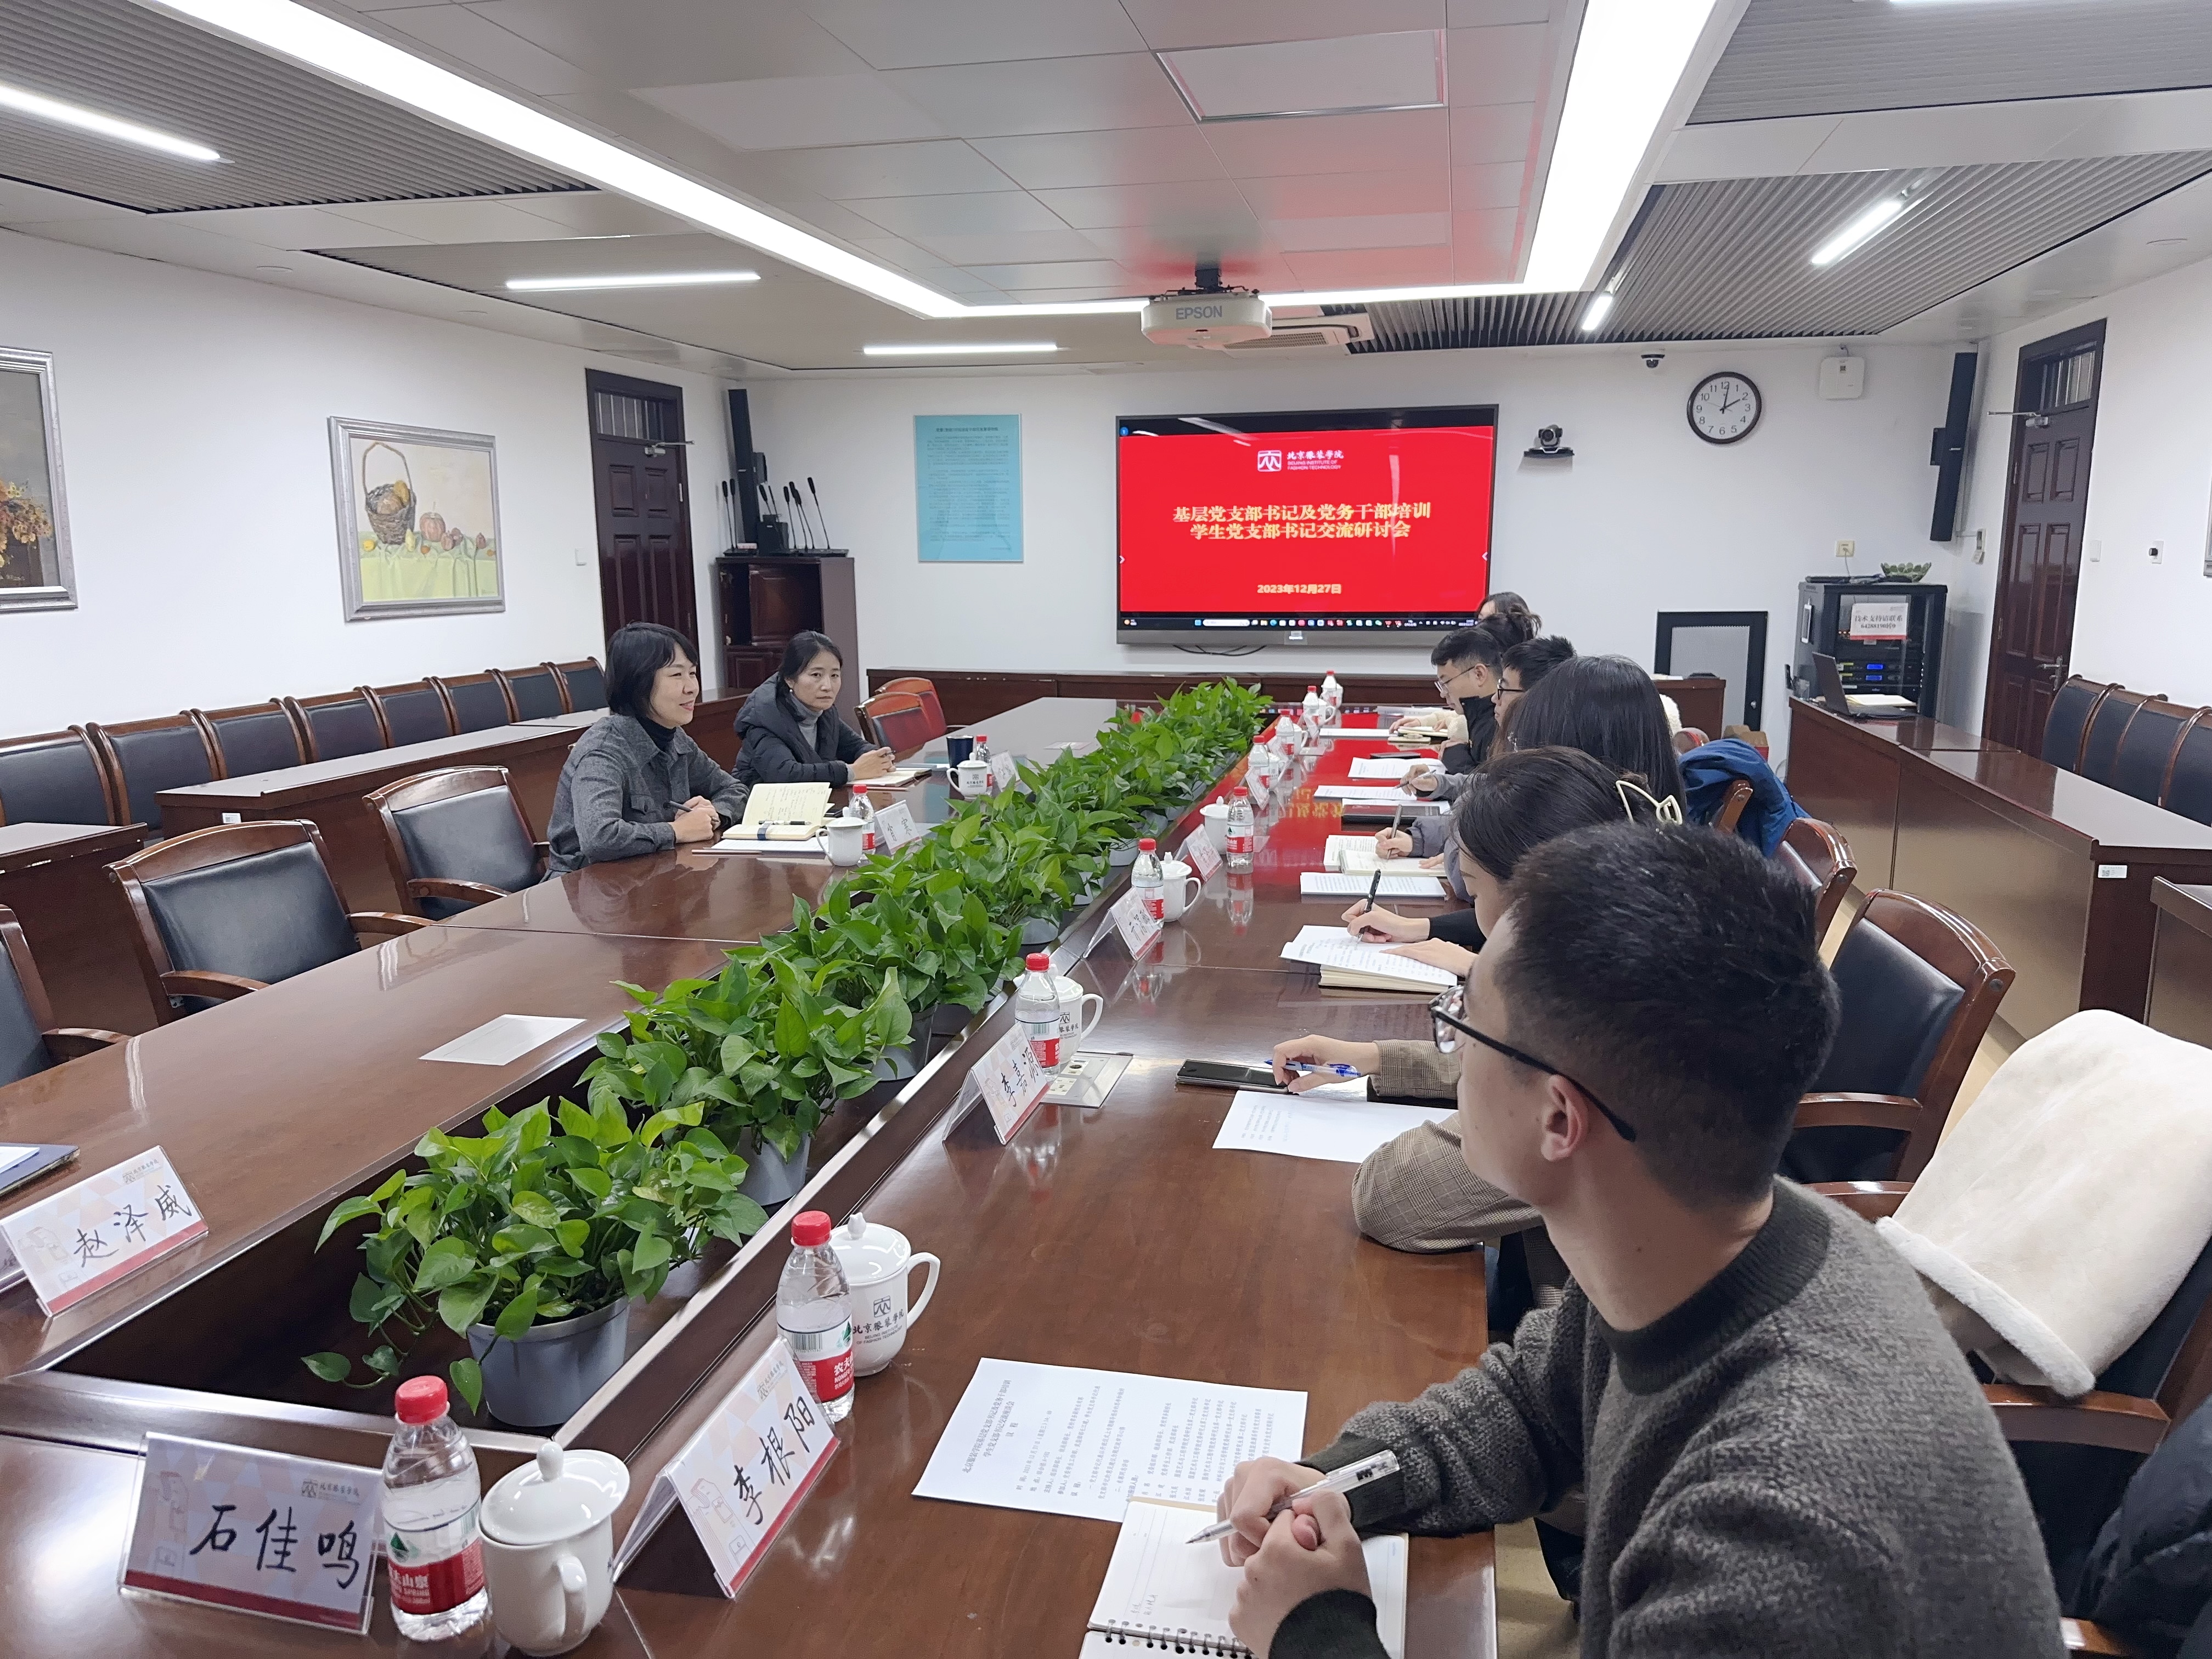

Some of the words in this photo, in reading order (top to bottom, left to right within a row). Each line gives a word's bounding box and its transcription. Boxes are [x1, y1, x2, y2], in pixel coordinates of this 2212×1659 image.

[1176, 306, 1222, 320] EPSON
[1701, 393, 1709, 401] 10
[1742, 392, 1748, 400] 2
[1696, 405, 1702, 413] 9
[1745, 403, 1751, 411] 3
[1699, 416, 1705, 425] 8
[1719, 427, 1725, 435] 6
[1172, 501, 1431, 522] 基层党支部书记及党务干部培训
[1190, 520, 1411, 540] 学生党支部书记交流研讨会
[1257, 584, 1342, 594] 2023年12月27日
[1001, 1047, 1039, 1107] 李嘉源
[74, 1185, 192, 1267] 赵泽威
[733, 1396, 815, 1524] 李根阳
[189, 1505, 360, 1589] 石佳鸣
